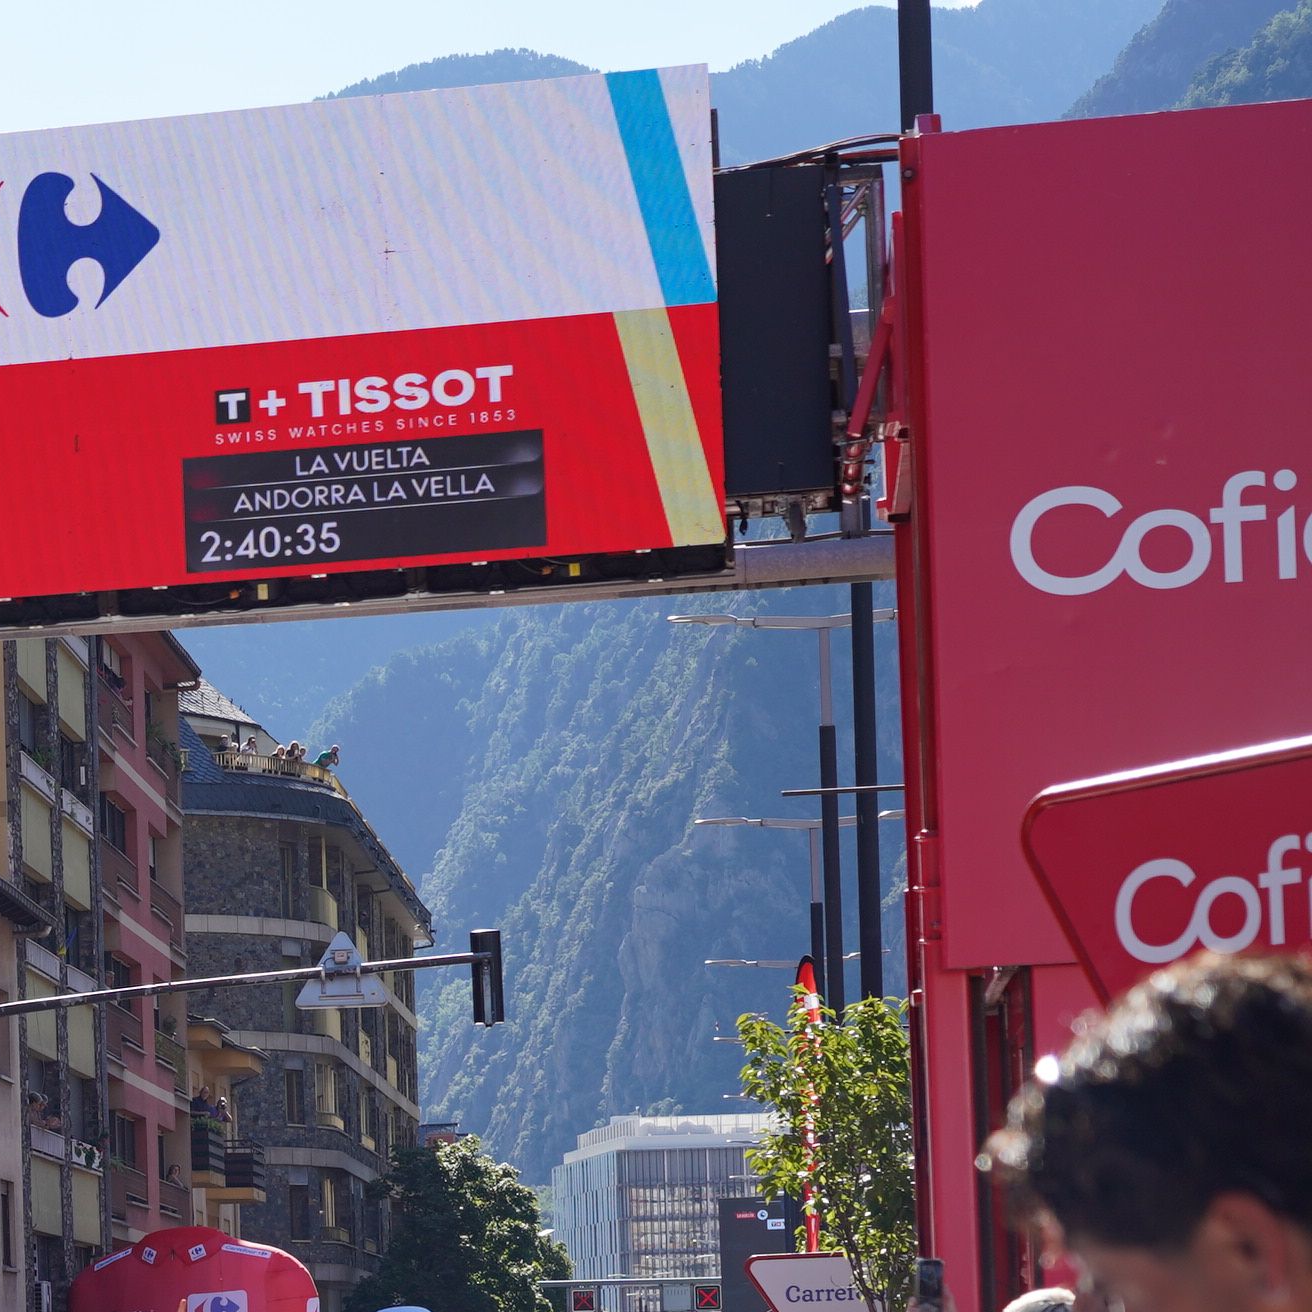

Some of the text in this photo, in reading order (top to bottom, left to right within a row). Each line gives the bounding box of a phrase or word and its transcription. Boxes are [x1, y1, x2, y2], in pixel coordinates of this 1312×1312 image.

[298, 365, 514, 418] TISSOT
[214, 409, 517, 446] SWISS WATCHES SINCE 1853
[296, 446, 431, 477] LA VUELTA
[233, 472, 496, 514] ANDORRA LA VELLA
[200, 522, 340, 564] 2:40:35
[1010, 470, 1312, 598] Cofi
